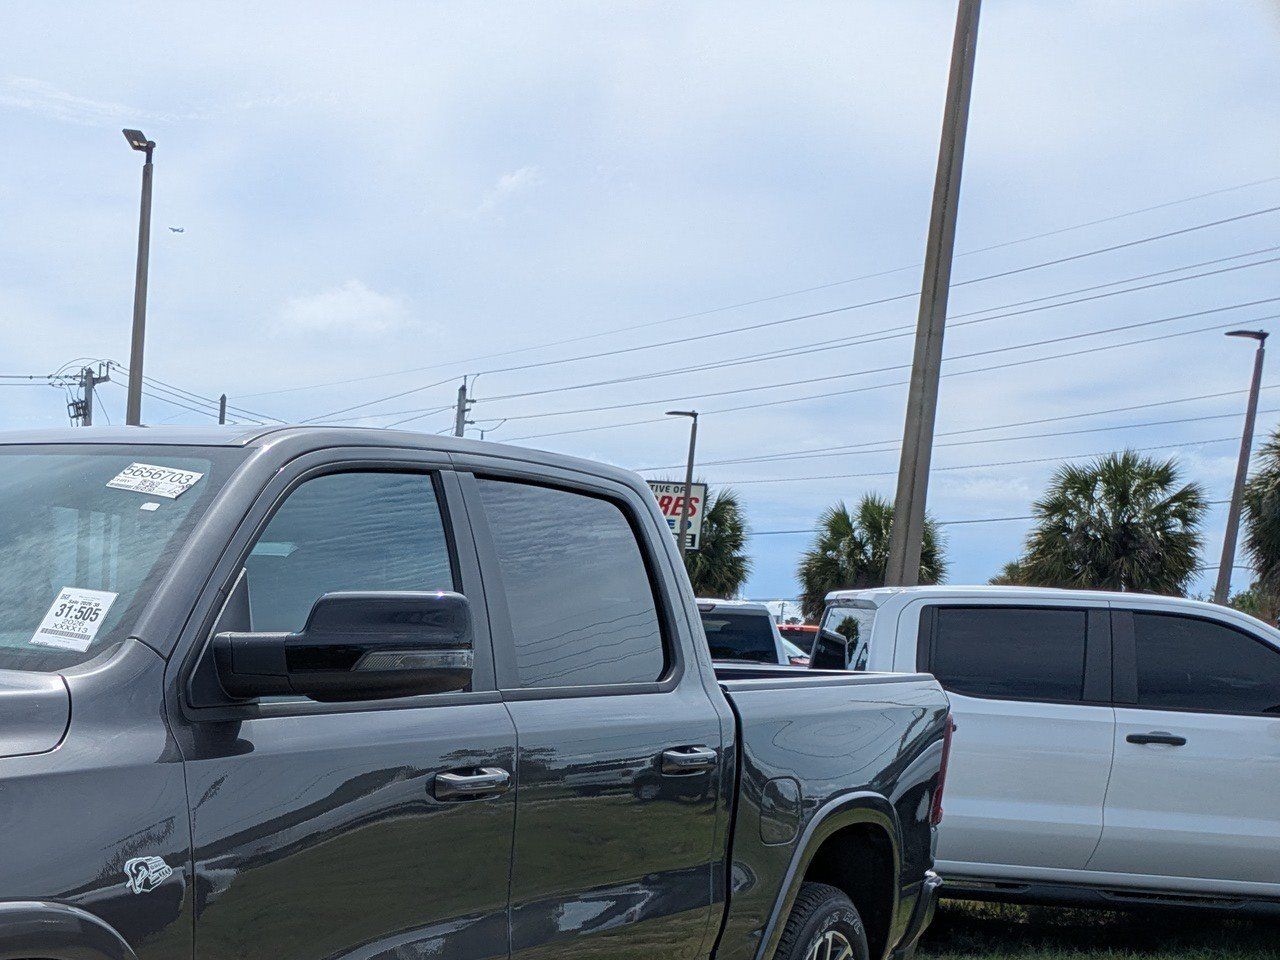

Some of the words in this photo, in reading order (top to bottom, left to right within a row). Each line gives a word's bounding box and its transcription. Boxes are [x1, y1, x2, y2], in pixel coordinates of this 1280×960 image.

[122, 465, 194, 485] 5656703
[54, 603, 102, 623] 31:505
[61, 618, 86, 627] 2026
